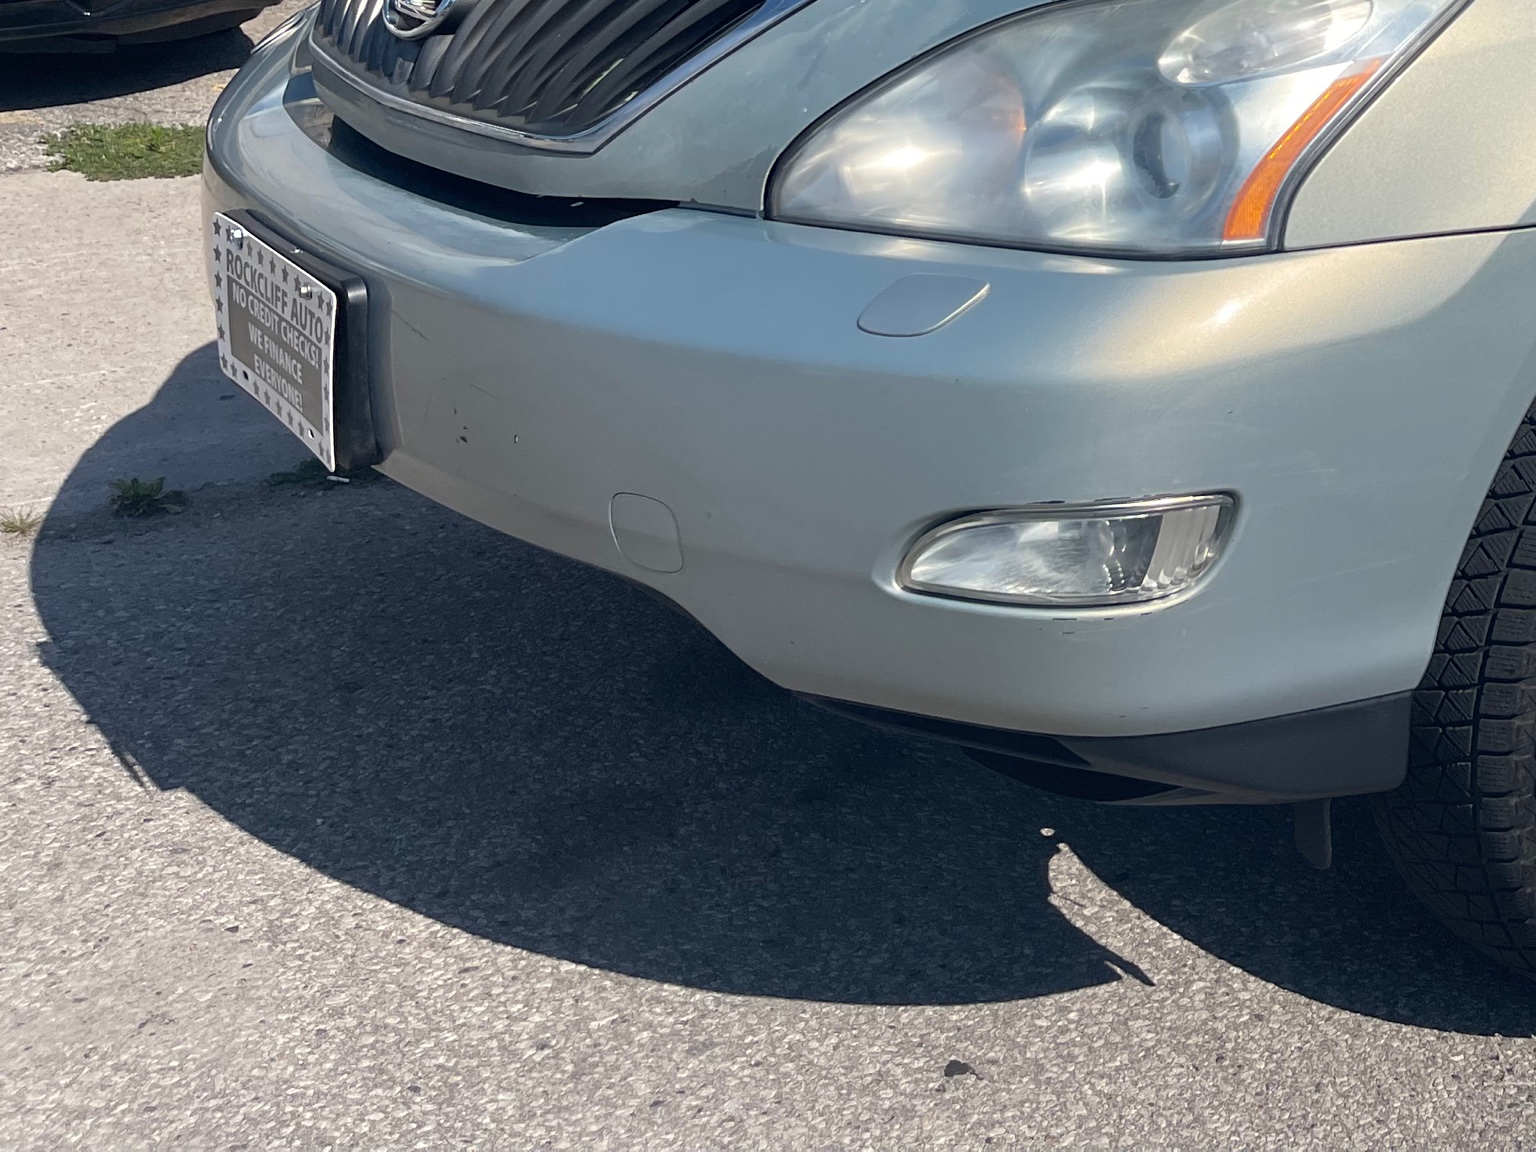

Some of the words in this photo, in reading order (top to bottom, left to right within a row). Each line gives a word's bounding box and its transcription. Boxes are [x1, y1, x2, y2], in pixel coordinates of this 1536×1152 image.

[227, 249, 288, 315] ROCKCLIFF
[290, 298, 323, 344] AUTO
[232, 282, 247, 308] NO
[249, 294, 280, 334] CREDIT
[280, 319, 319, 369] CHECKS!
[248, 322, 263, 348] WE
[264, 335, 302, 384] FINANCE
[253, 354, 303, 413] EVERYONE!
